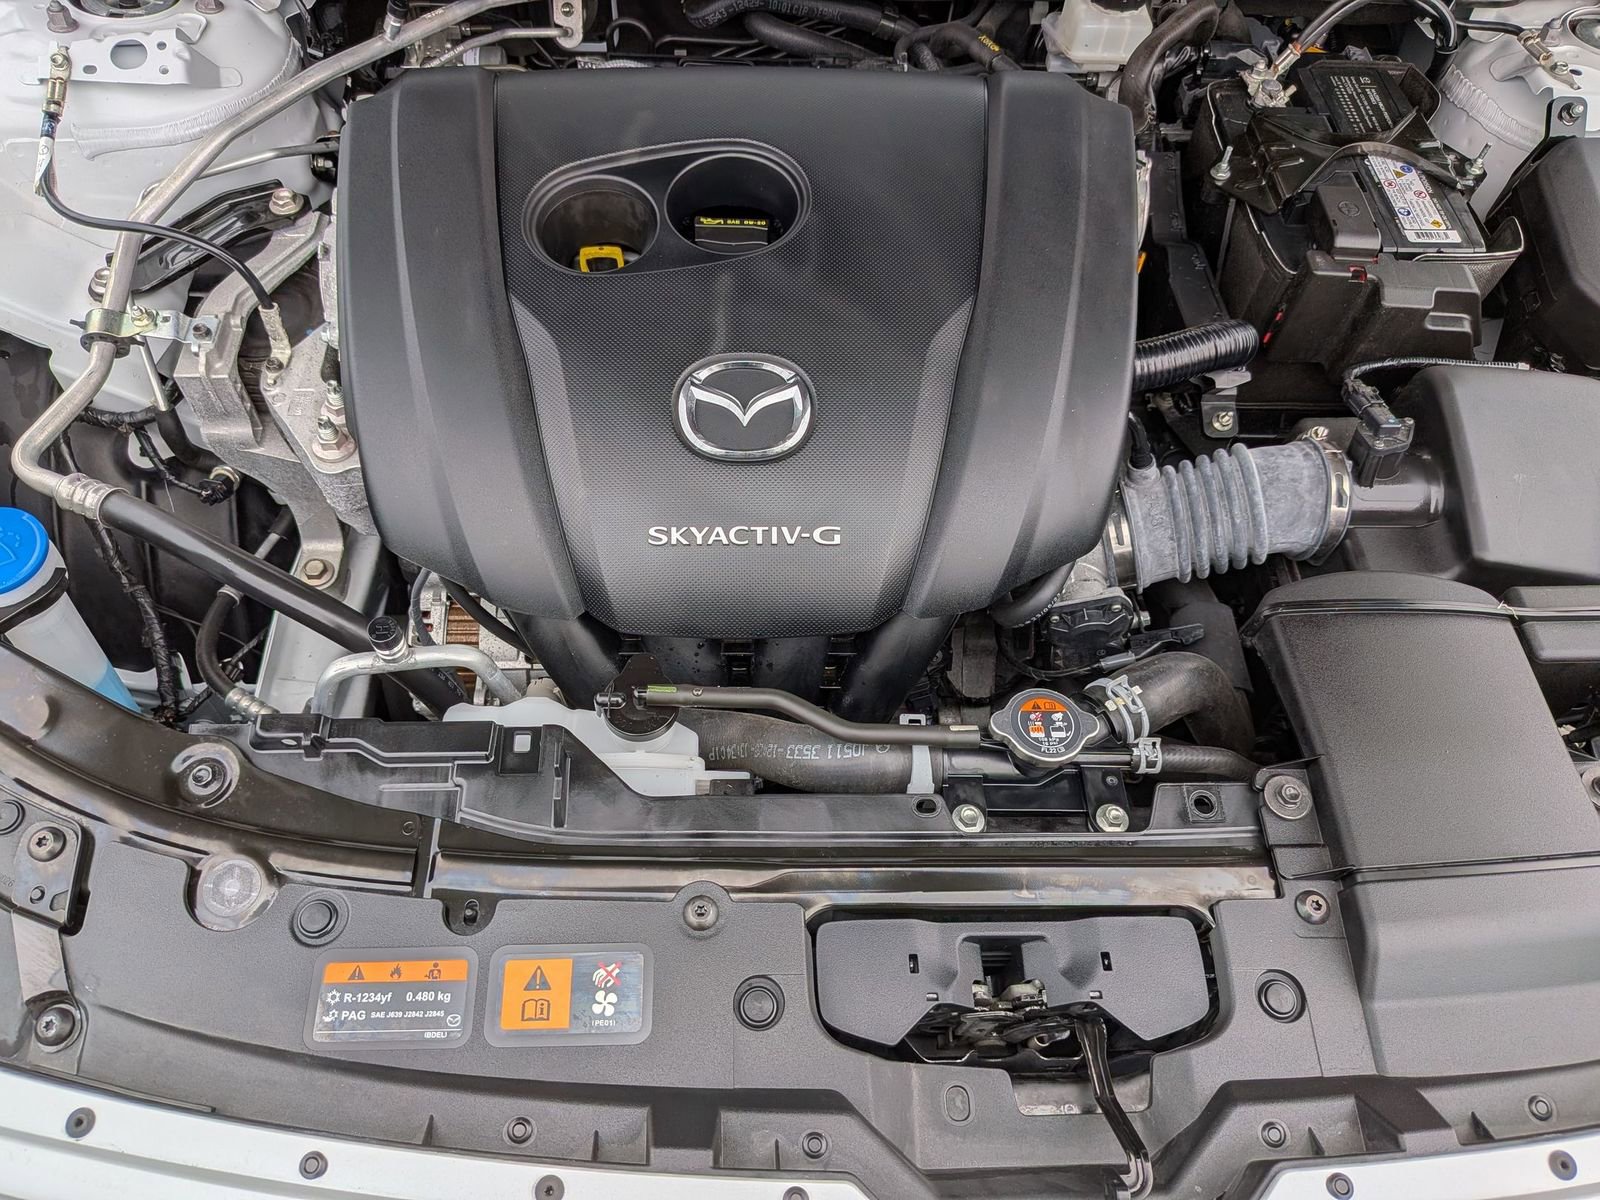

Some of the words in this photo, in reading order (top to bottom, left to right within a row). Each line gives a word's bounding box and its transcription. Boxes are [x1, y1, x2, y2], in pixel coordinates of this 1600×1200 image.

[648, 525, 841, 546] SKYACTIV-G
[785, 744, 821, 760] 3533
[343, 992, 392, 1004] R-1234yf
[406, 991, 435, 1002] 0.480
[437, 991, 451, 1003] kg
[341, 1010, 366, 1021] PAG
[370, 1011, 385, 1019] SAE
[424, 1010, 445, 1018] J2845
